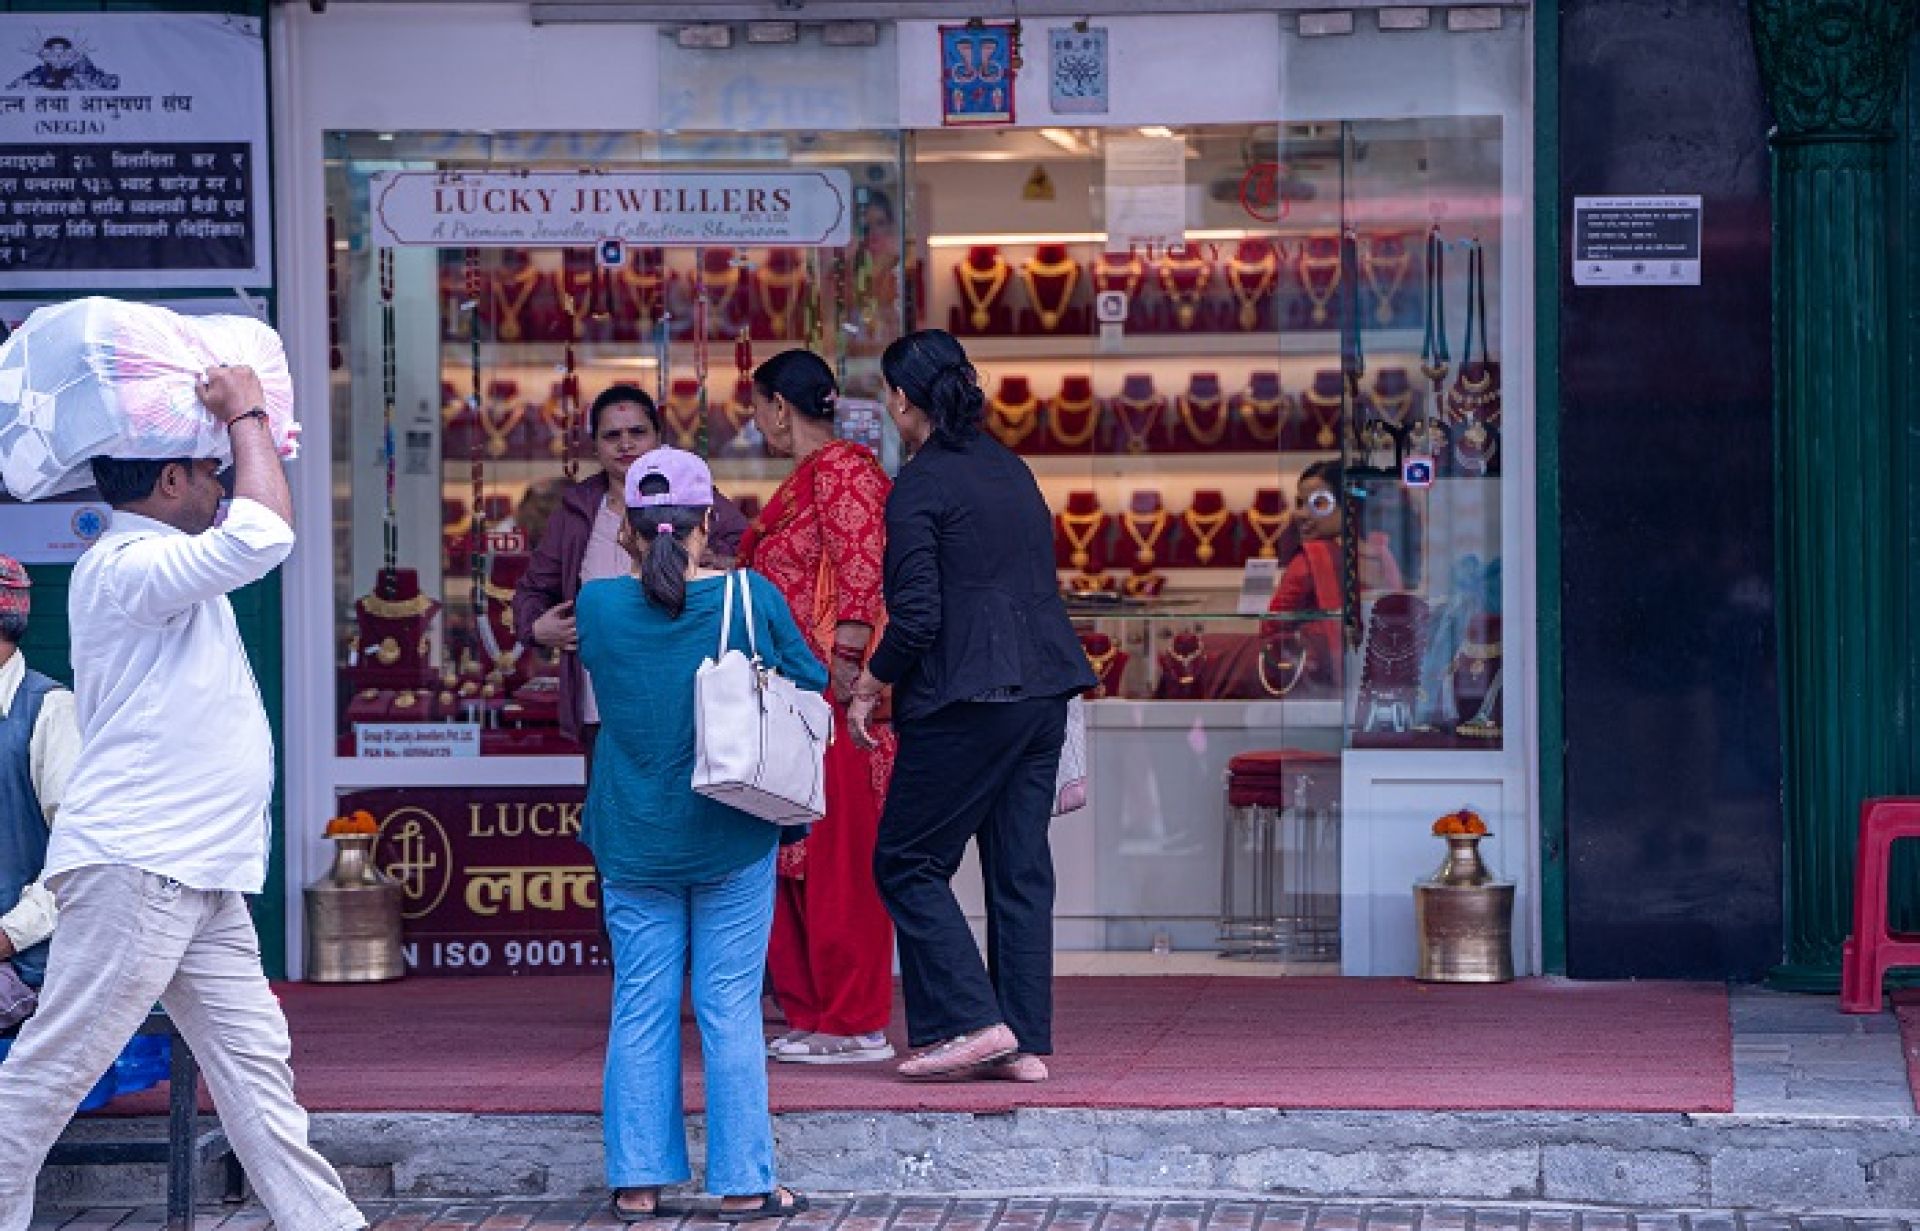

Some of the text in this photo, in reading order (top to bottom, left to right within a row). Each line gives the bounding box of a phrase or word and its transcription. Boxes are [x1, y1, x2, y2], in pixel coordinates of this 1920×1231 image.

[35, 120, 105, 134] (NEGJA)
[433, 188, 792, 214] LUCKY JEWELLERS
[431, 219, 790, 240] A Premium Jewellery Collection Showroom
[468, 802, 585, 837] LUCK
[432, 941, 491, 967] ISO
[503, 940, 610, 968] 9001:
